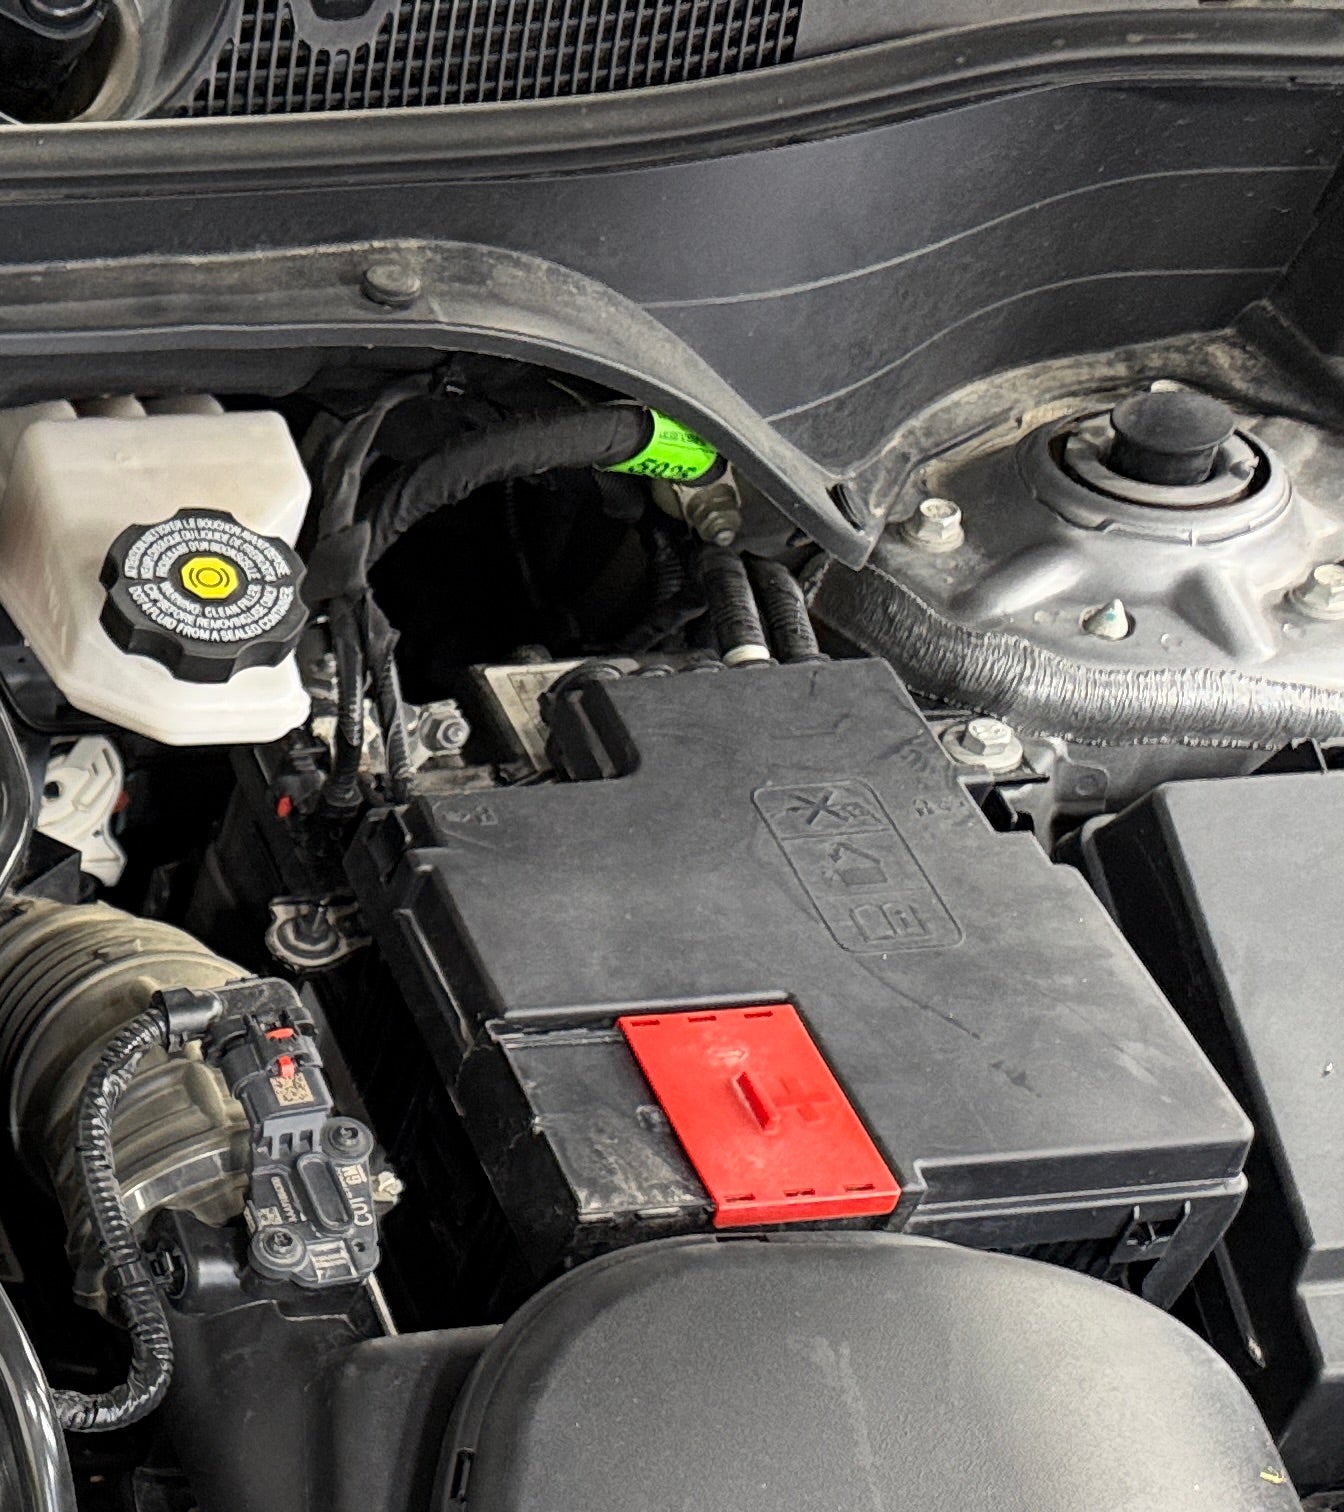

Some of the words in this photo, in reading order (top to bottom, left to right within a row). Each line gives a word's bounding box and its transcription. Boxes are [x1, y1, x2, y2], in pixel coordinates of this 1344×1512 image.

[204, 604, 241, 618] CLEAN
[176, 622, 210, 641] FROM
[210, 630, 221, 643] A
[220, 623, 263, 643] SEALED
